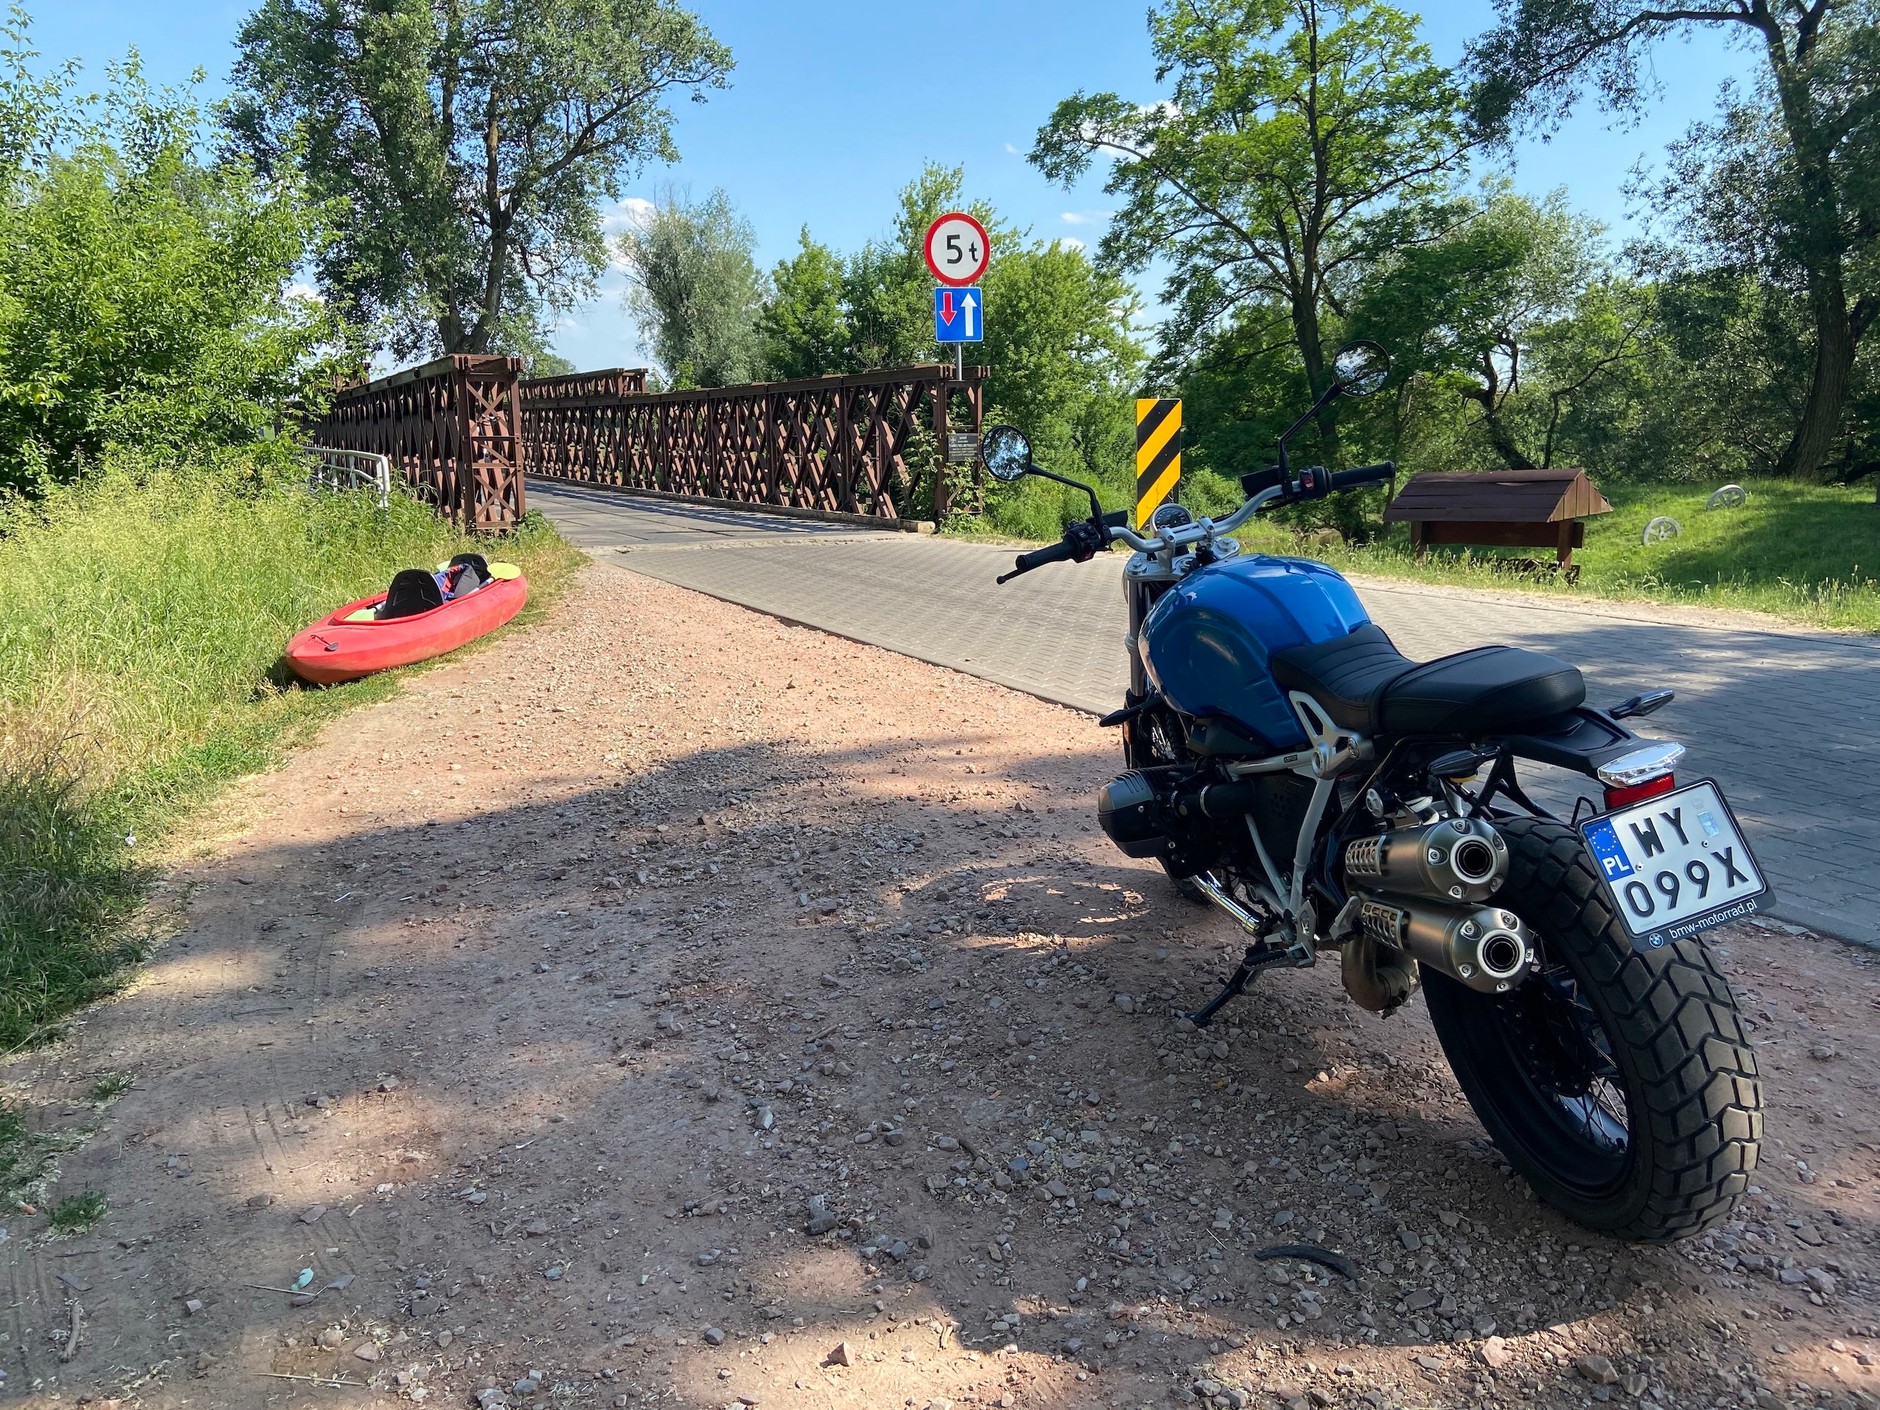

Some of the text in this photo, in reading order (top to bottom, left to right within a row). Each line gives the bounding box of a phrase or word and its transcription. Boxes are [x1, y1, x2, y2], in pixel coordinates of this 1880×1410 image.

[1629, 806, 1690, 858] WY
[1602, 856, 1630, 876] PL
[1624, 846, 1750, 918] 099X
[1668, 898, 1758, 940] bmw-motorrad.pl
